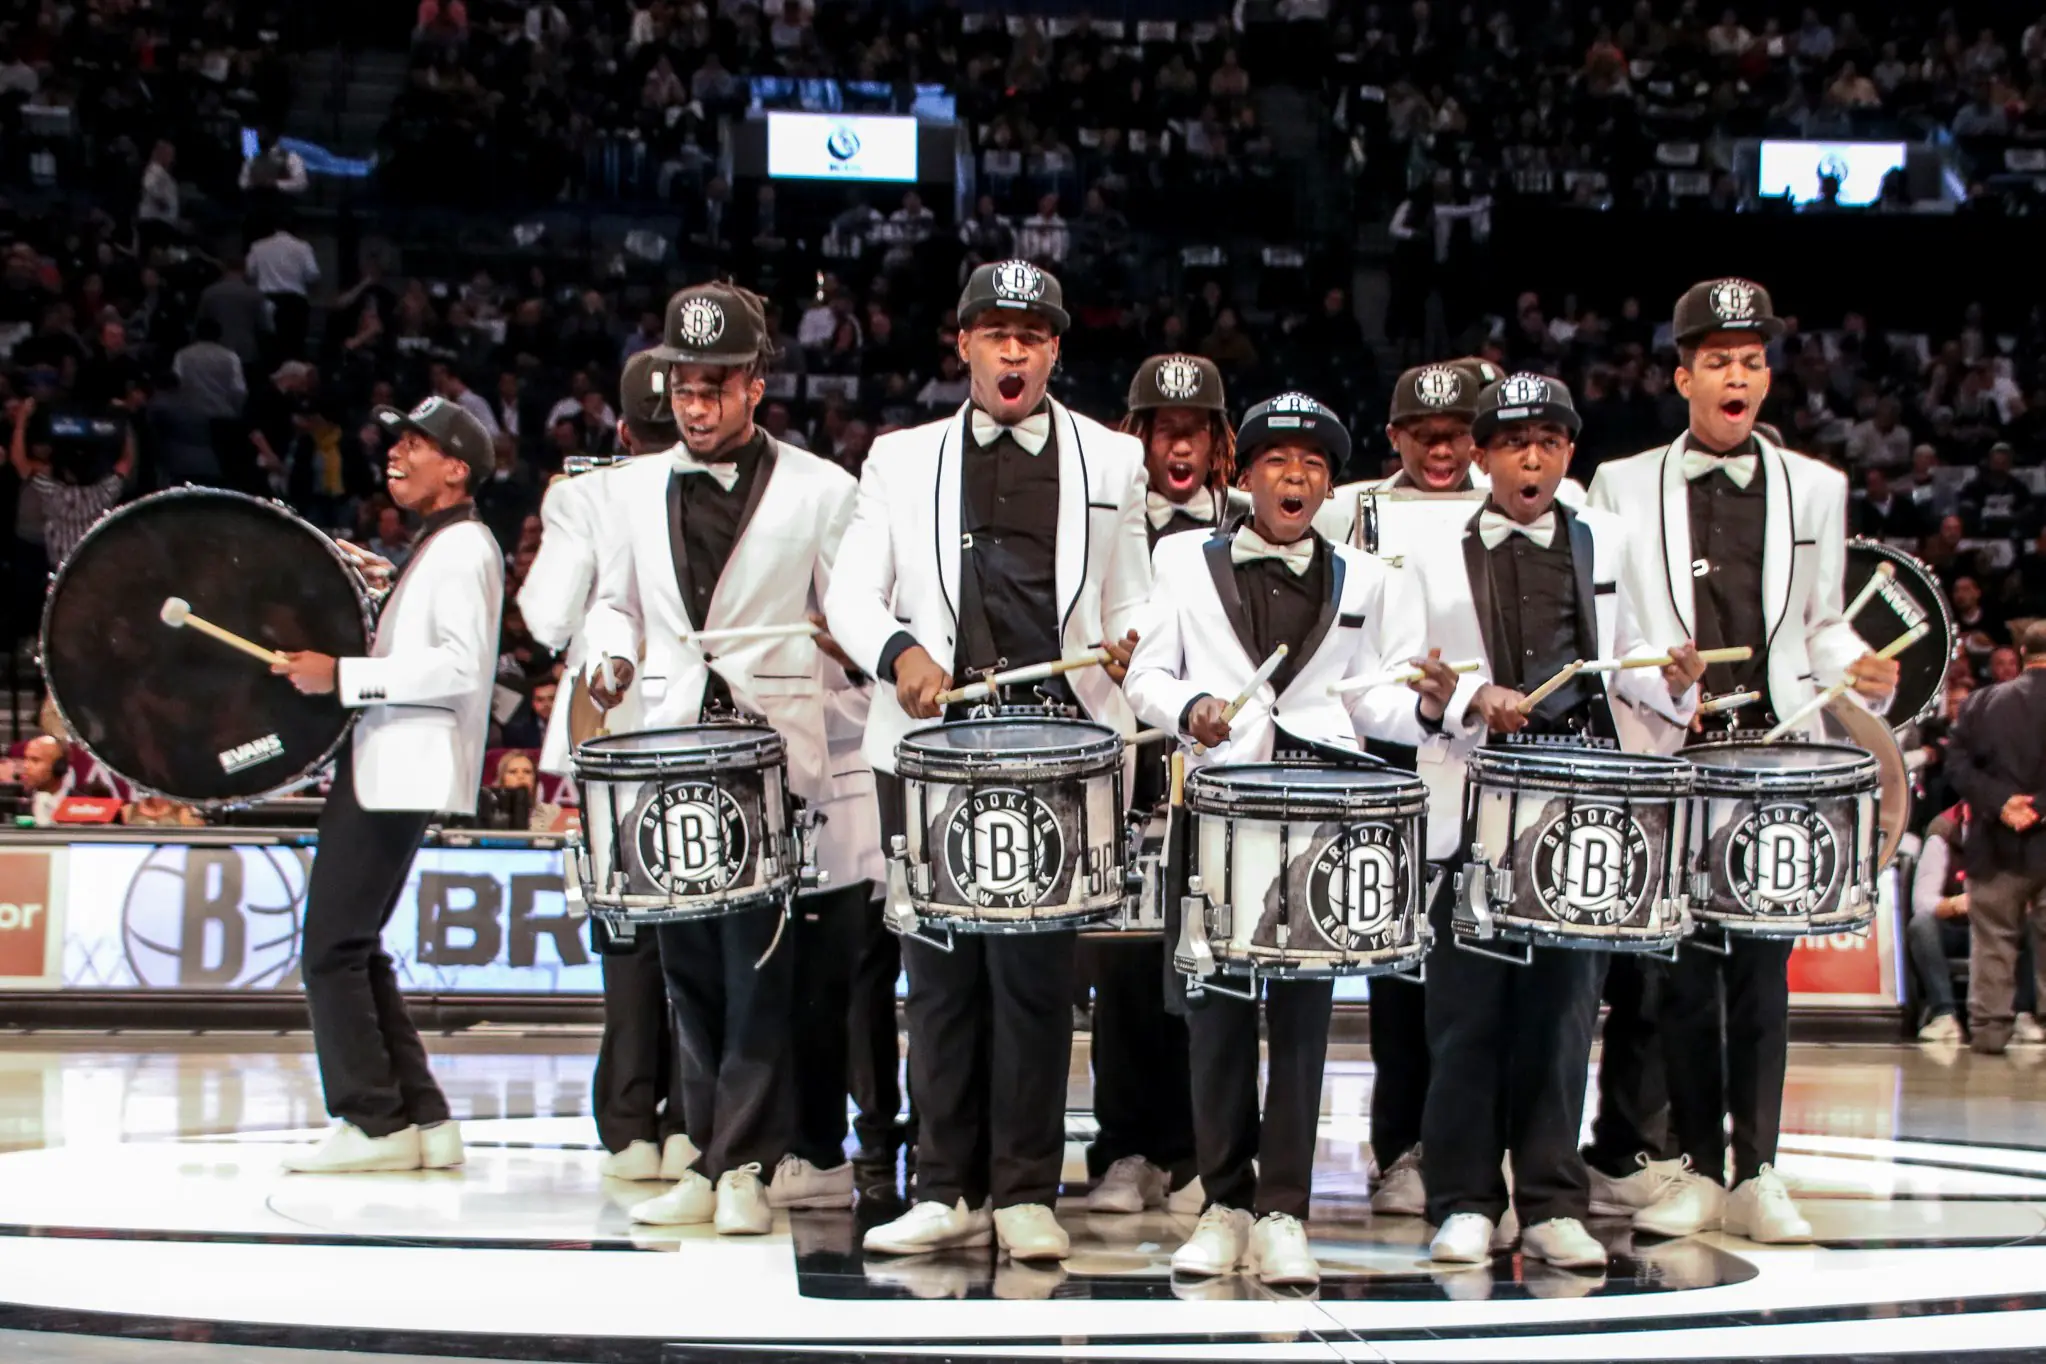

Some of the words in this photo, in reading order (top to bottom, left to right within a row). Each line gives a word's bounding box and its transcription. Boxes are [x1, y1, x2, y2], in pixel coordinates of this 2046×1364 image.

[680, 814, 707, 871] B
[990, 821, 1017, 882] B
[1581, 838, 1608, 898] B
[1772, 836, 1796, 890] B
[1359, 859, 1381, 922] B
